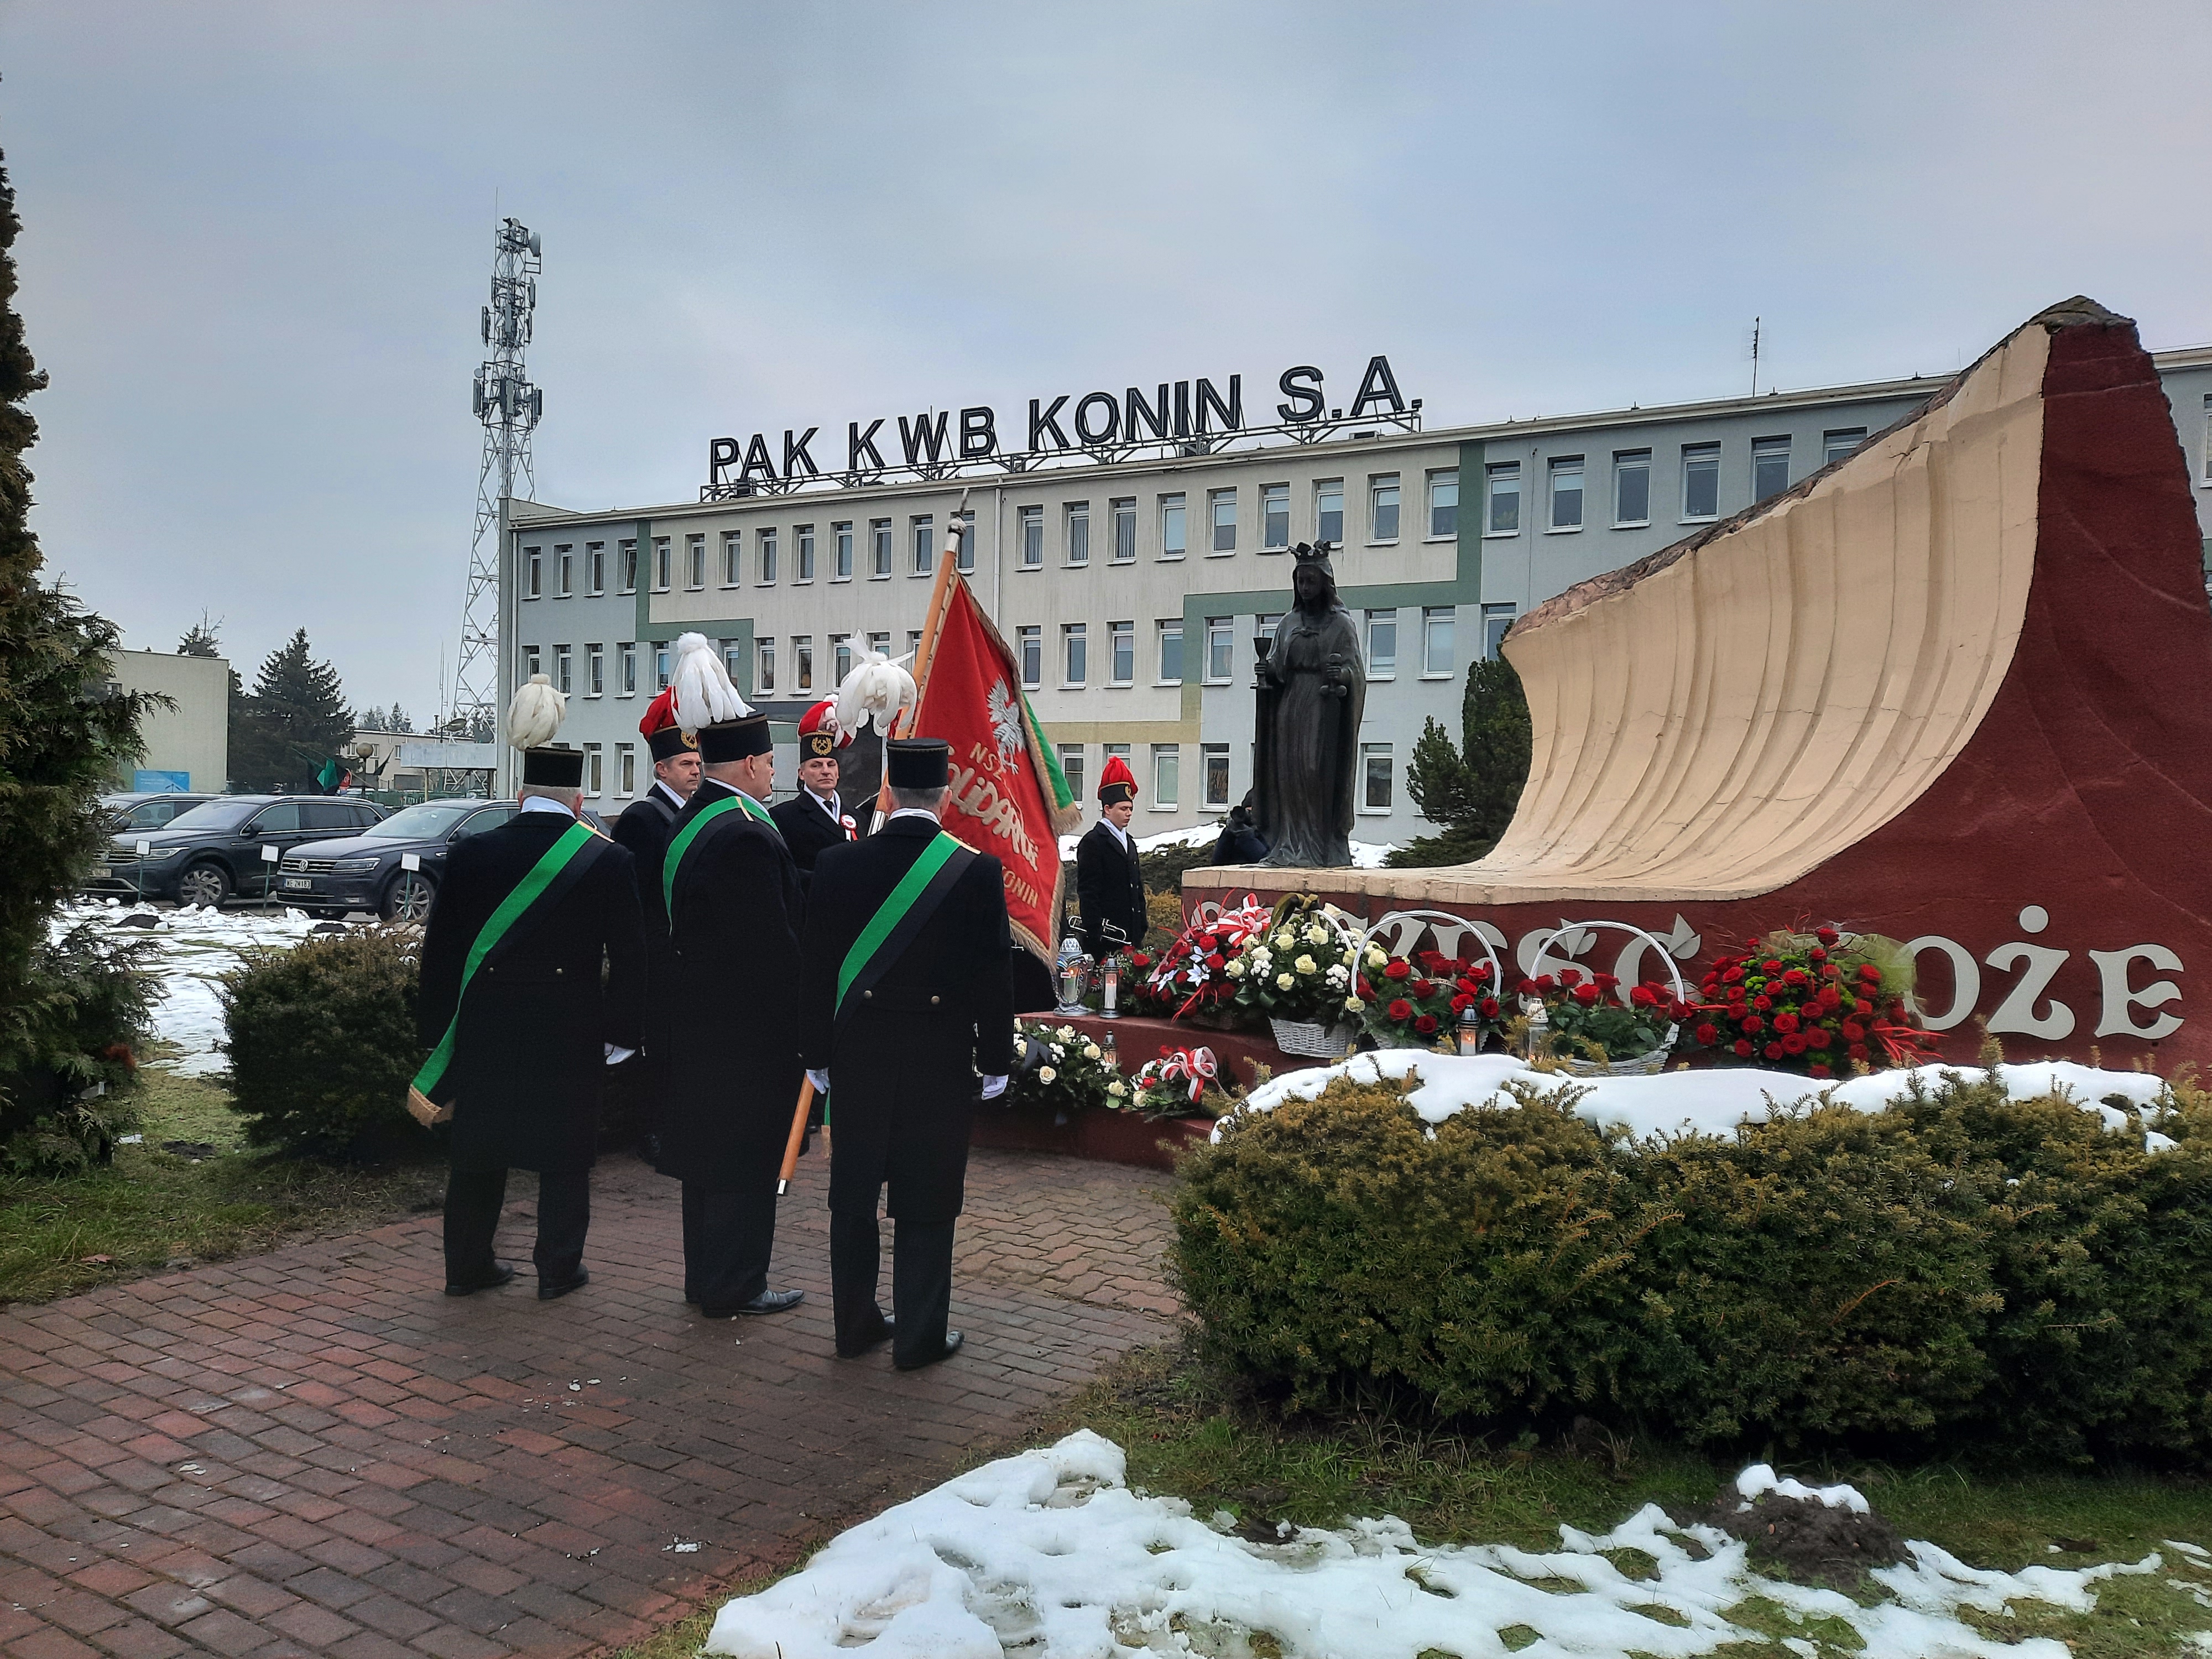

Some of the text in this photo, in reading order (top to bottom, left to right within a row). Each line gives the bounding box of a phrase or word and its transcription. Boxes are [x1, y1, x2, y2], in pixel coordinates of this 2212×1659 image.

[710, 355, 1423, 484] PAK KWB KONIN S.A.
[1001, 865, 1039, 909] ONIN
[1839, 904, 2185, 1041] OŻE
